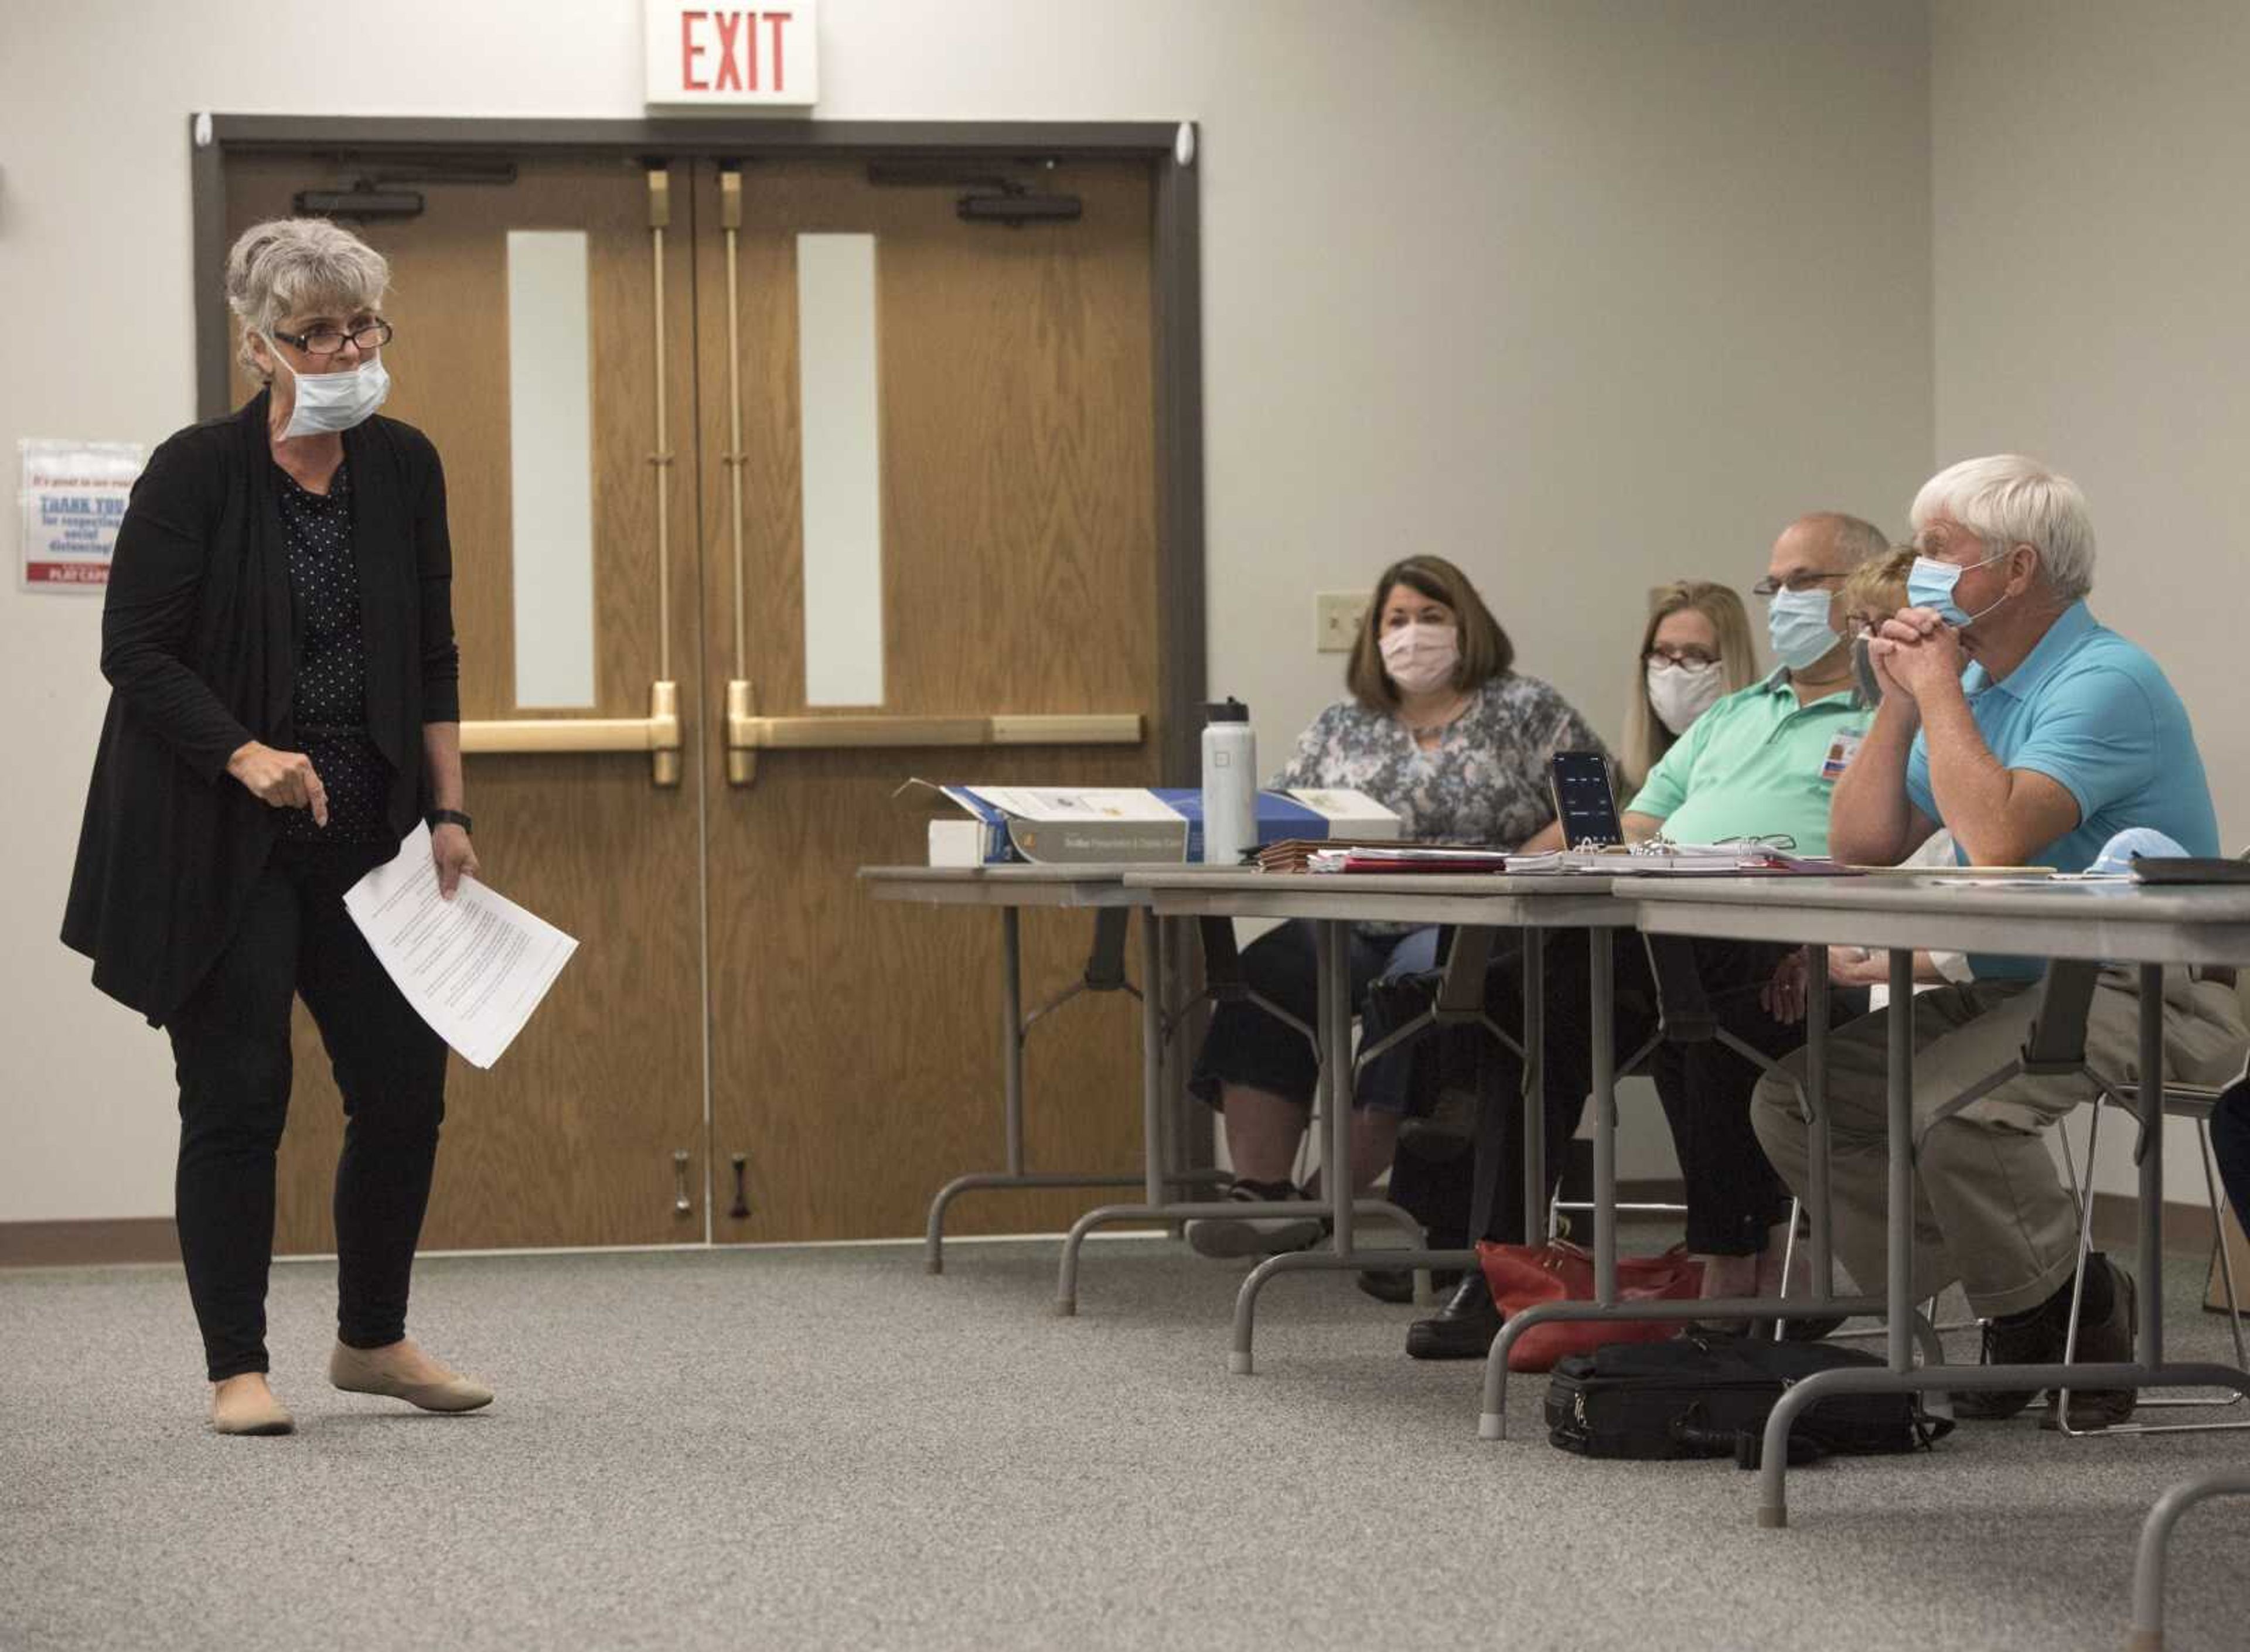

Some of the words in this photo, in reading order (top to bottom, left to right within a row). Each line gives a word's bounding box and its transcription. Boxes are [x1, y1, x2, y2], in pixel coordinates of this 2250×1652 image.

[681, 11, 793, 91] EXIT
[40, 496, 91, 514] THANK
[95, 497, 124, 515] YOU
[43, 514, 58, 525] for
[64, 528, 98, 538] social
